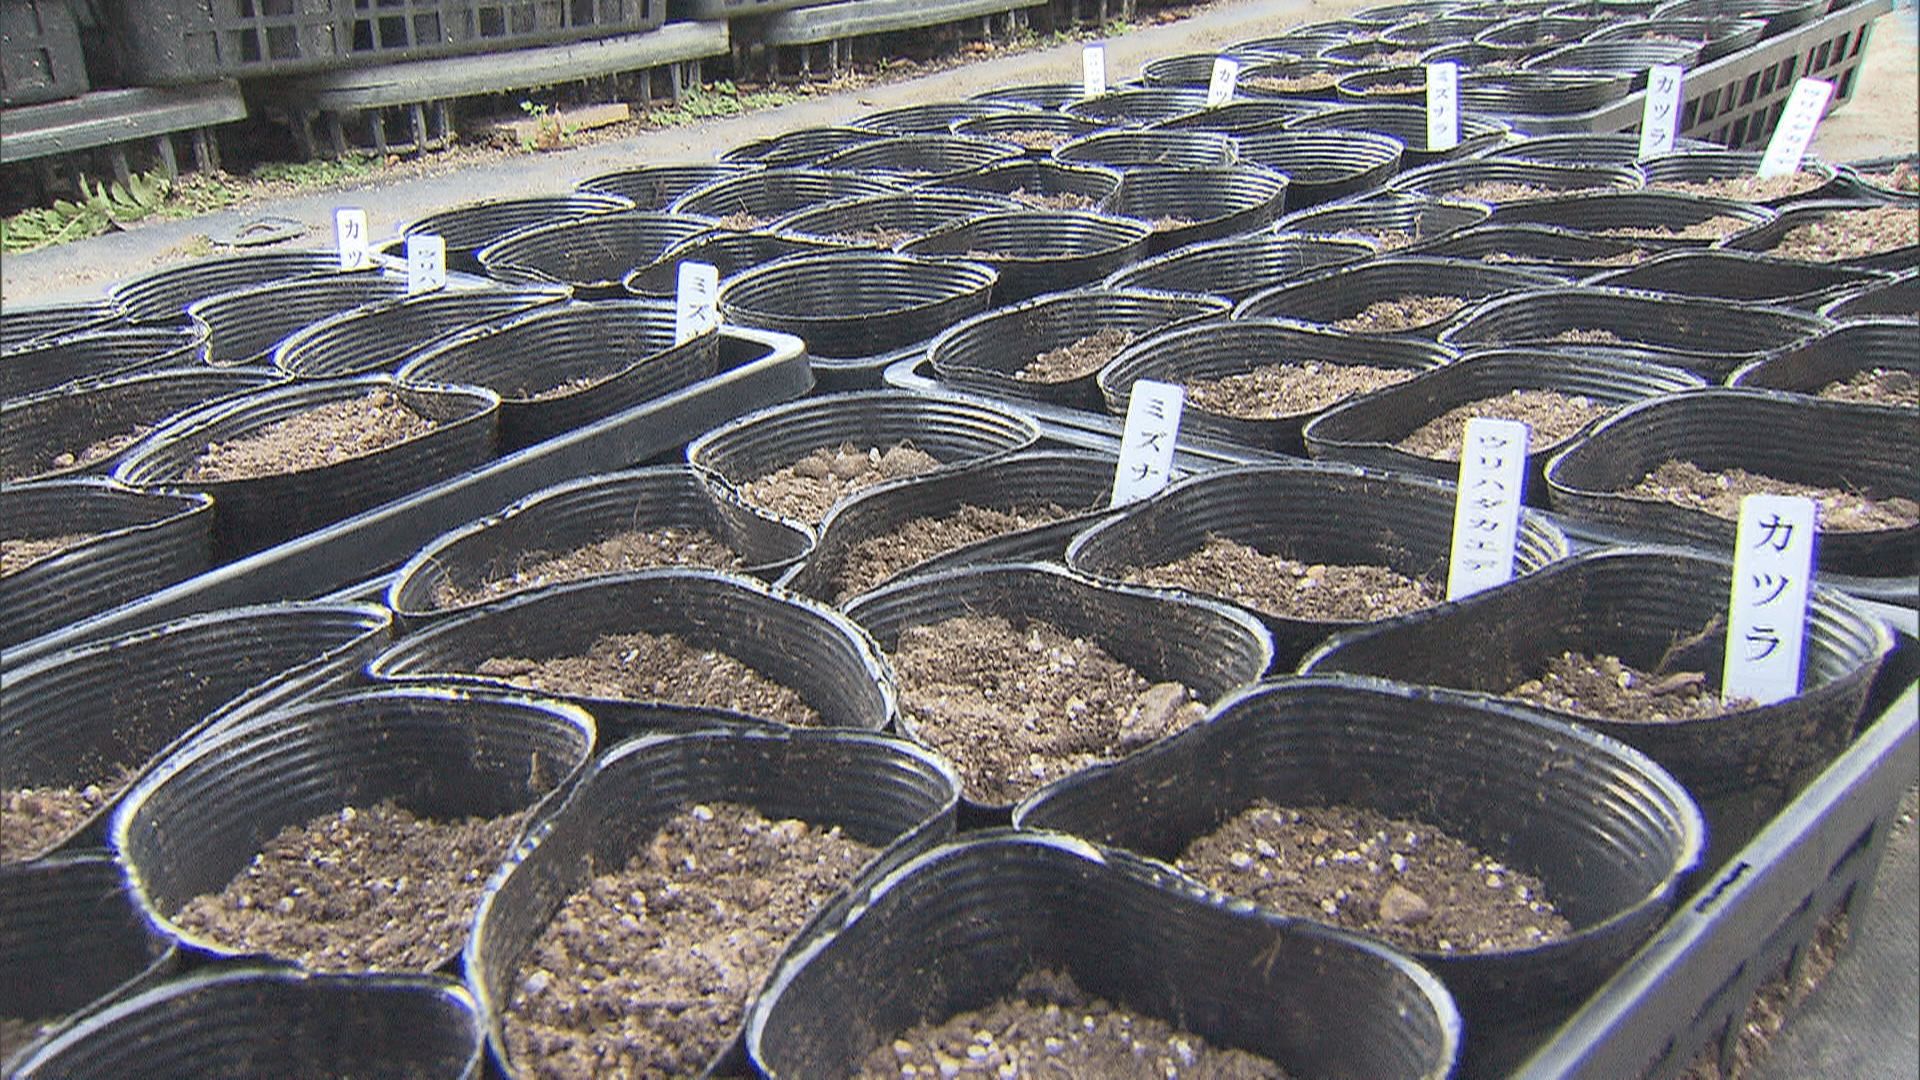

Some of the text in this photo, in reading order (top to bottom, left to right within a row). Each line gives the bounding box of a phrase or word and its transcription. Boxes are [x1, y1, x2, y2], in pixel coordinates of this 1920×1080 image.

[1651, 76, 1674, 147] カツラ
[344, 219, 362, 267] カツ
[1129, 399, 1167, 502] ミズナ
[1744, 513, 1793, 662] カツラ
